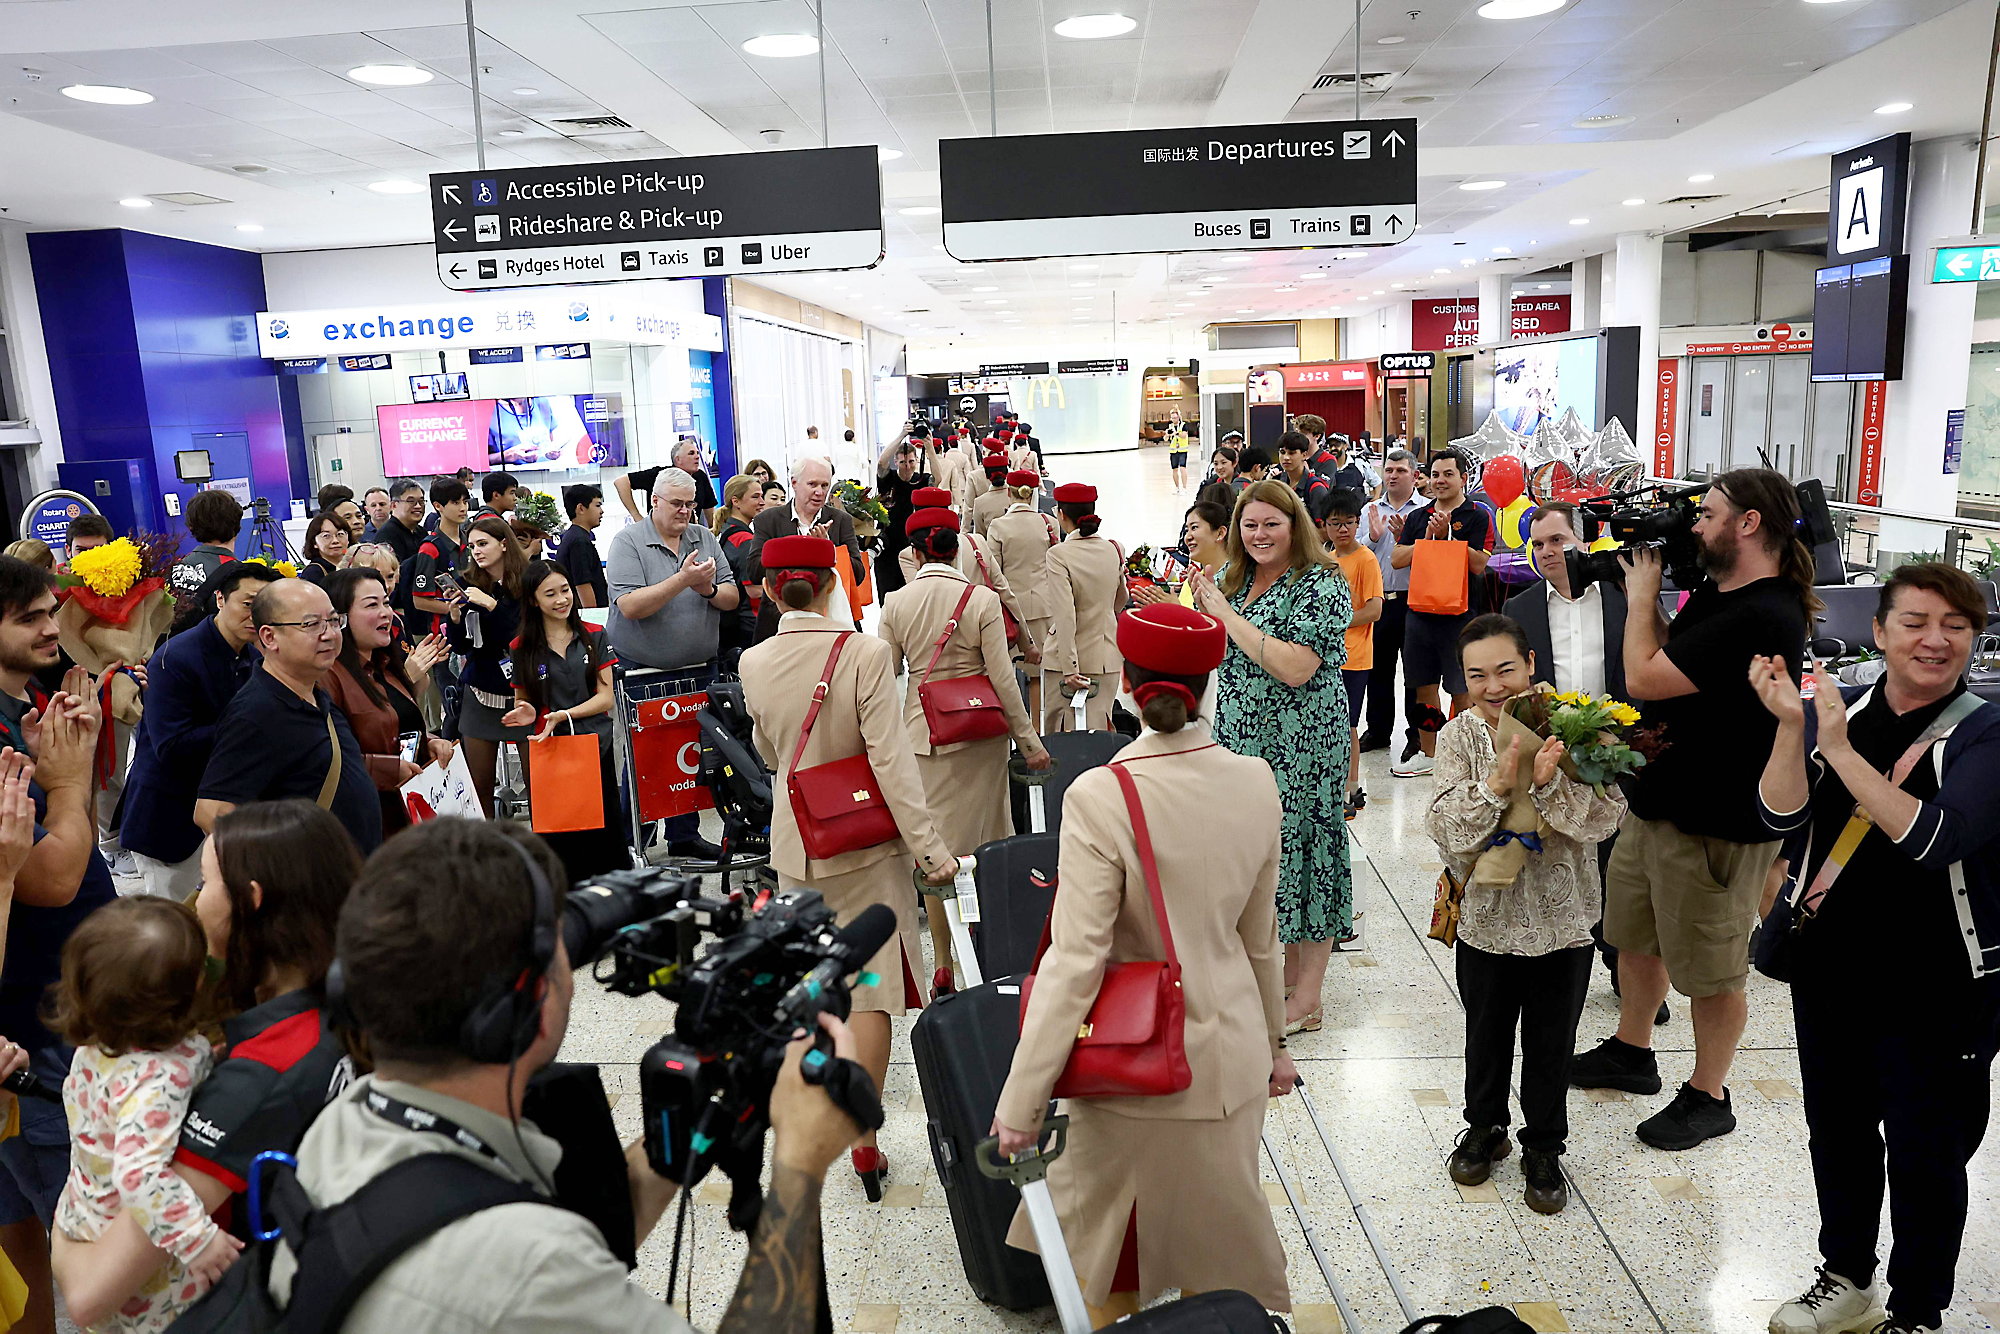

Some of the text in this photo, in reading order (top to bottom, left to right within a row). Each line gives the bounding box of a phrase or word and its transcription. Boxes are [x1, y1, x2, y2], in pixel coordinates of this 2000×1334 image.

[1143, 147, 1200, 163] 国际出发
[1208, 138, 1335, 164] Departures
[1849, 155, 1874, 171] Arrivals
[506, 171, 705, 201] Accessible Pick-up
[1846, 186, 1870, 240] A
[508, 207, 723, 236] Rideshare & Pick-up
[1194, 221, 1242, 237] Buses
[1290, 217, 1341, 234] Trains
[648, 250, 689, 266] Taxis
[771, 244, 811, 260] Uber
[506, 254, 605, 277] Rydges Hotel
[1432, 304, 1477, 314] CUSTOMS
[1535, 302, 1561, 311] AREA
[323, 315, 474, 341] exchange
[636, 313, 680, 340] exchange
[1445, 334, 1479, 346] PERS
[1383, 356, 1431, 368] OPTUS
[1298, 371, 1330, 381] ようこそ
[1663, 387, 1670, 400] NO
[1870, 381, 1879, 423] NO ENTRY
[399, 416, 464, 431] CURRENCY
[400, 428, 468, 444] EXCHANGE
[1660, 450, 1667, 462] NO
[1867, 444, 1874, 456] NO
[42, 509, 66, 517] Rotary
[681, 701, 710, 713] vodaf
[669, 779, 696, 792] voda
[187, 1110, 226, 1141] Barker
